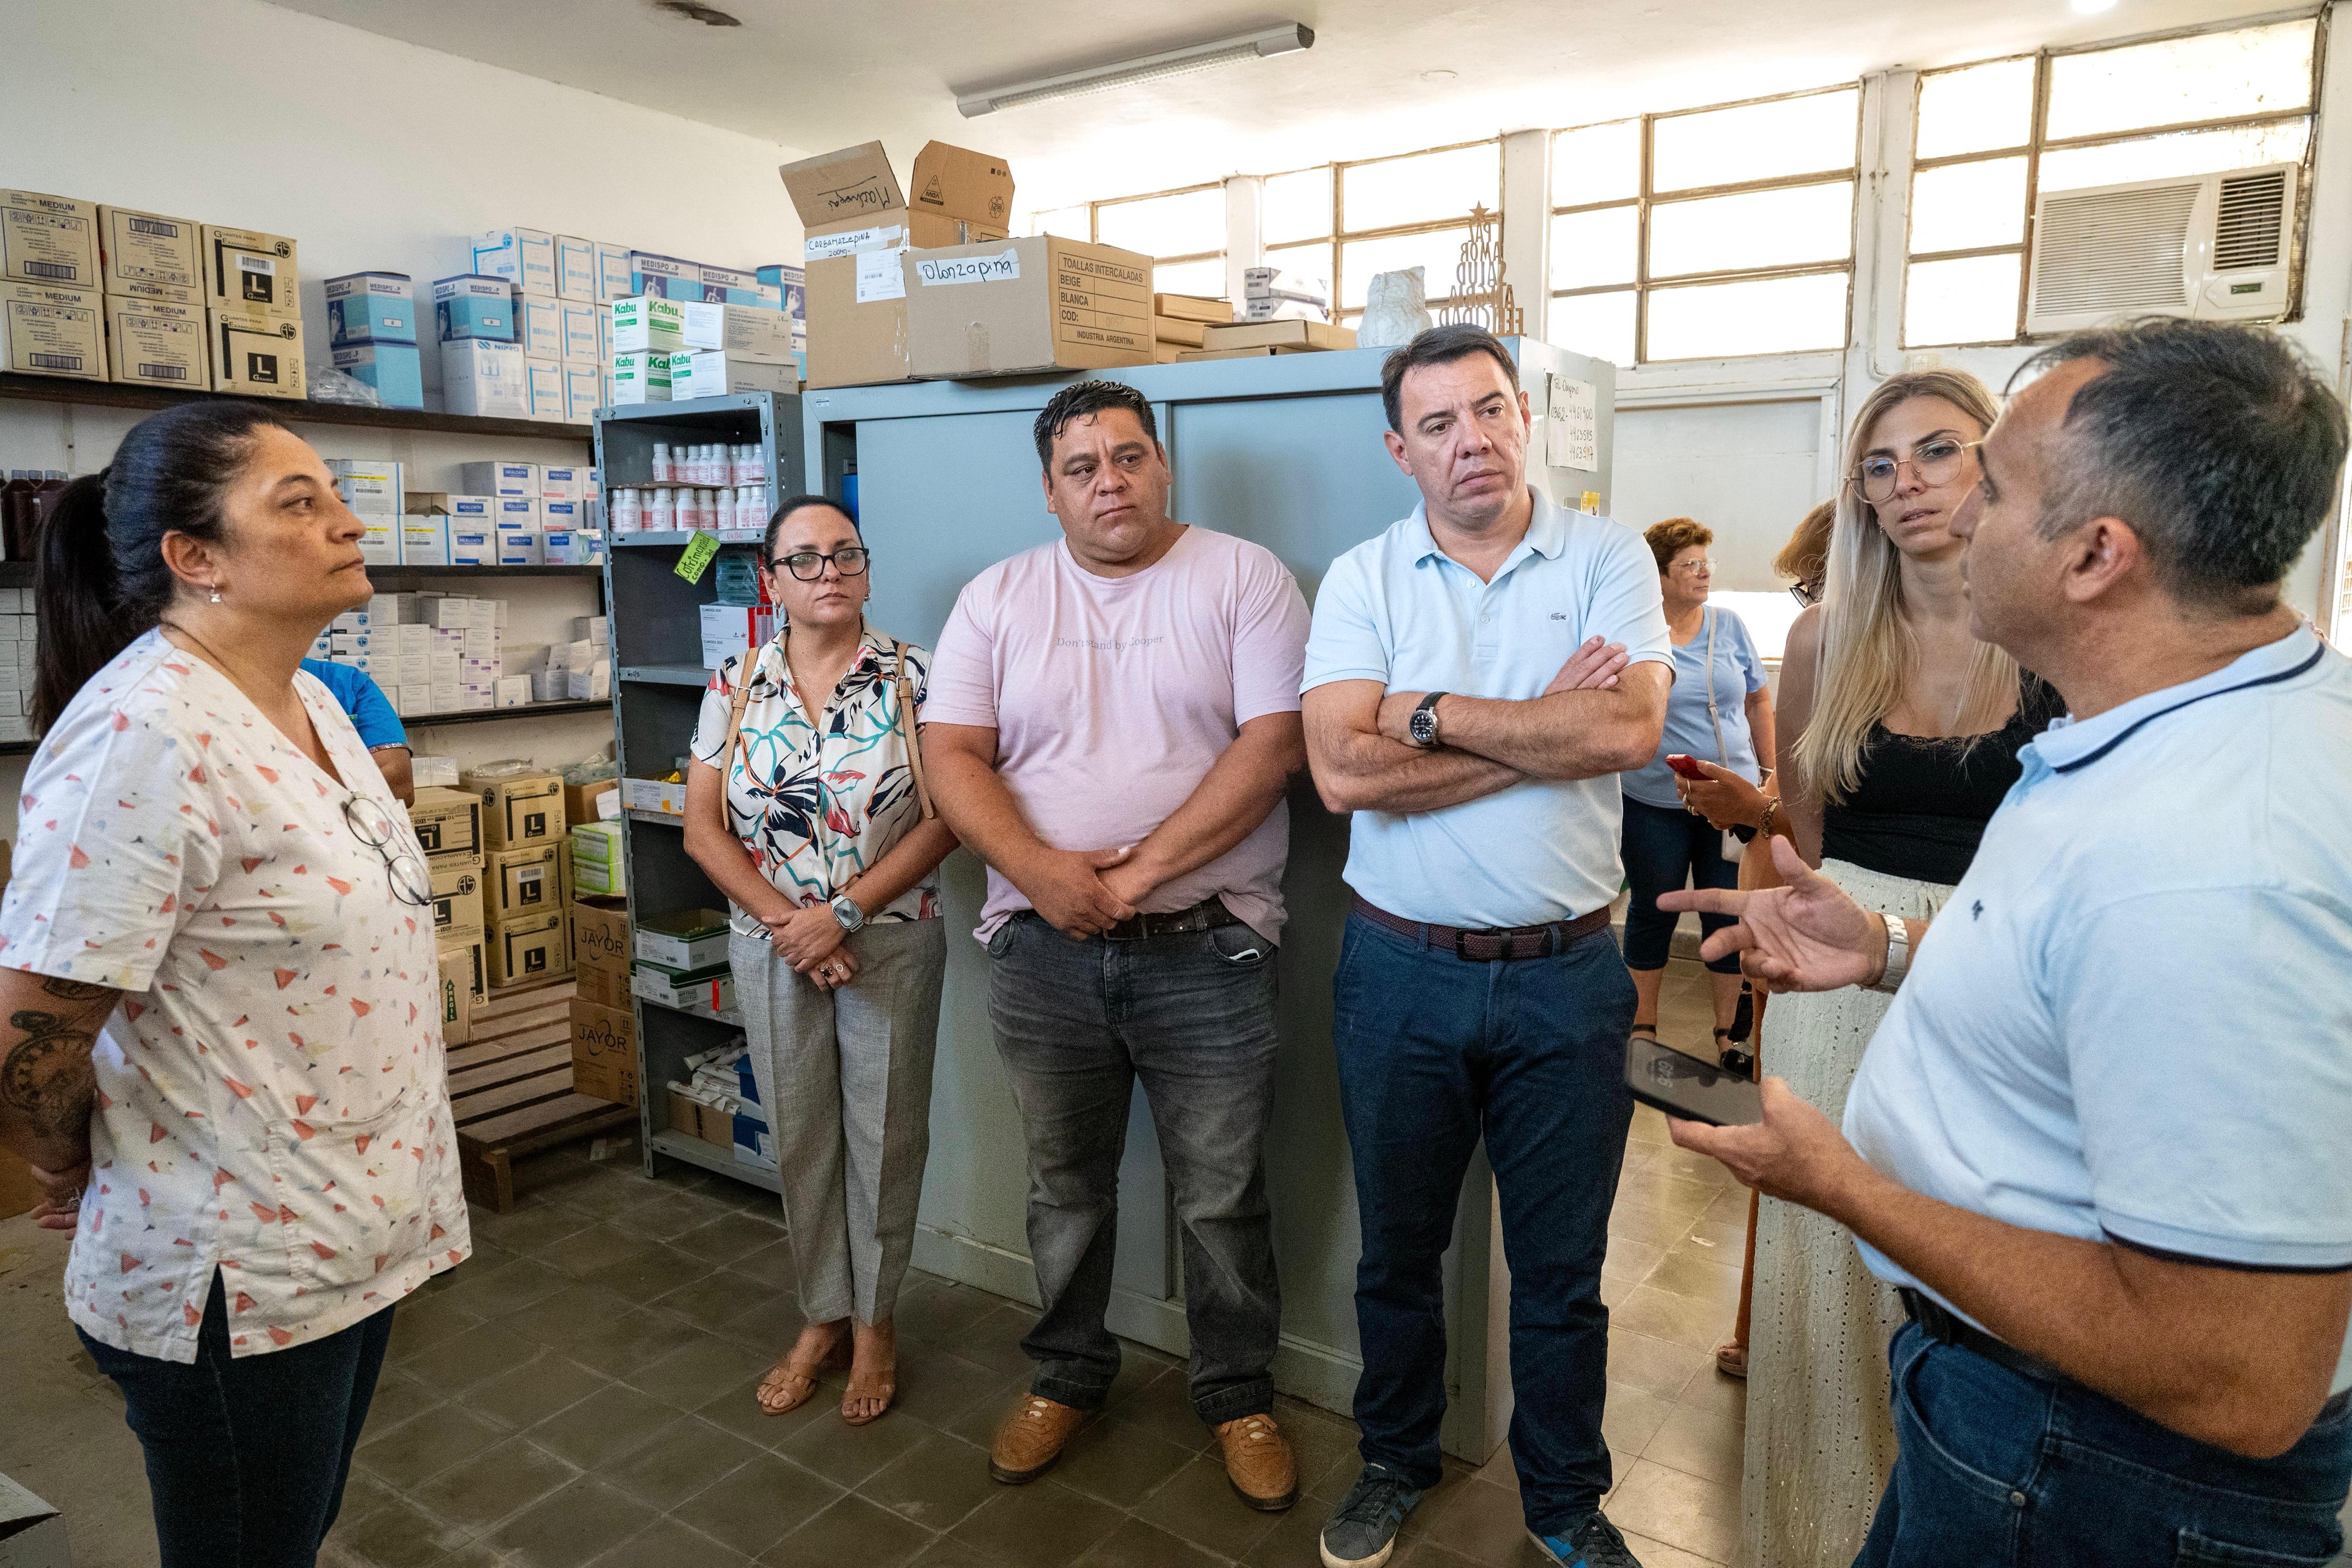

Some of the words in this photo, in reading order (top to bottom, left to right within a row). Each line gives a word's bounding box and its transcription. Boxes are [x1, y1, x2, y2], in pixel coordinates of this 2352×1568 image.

[40, 200, 75, 211] MEDIUM
[641, 259, 669, 270] MEDISPO
[1063, 257, 1093, 272] TOALLAS
[1095, 265, 1143, 283] INTERCALADAS
[703, 271, 729, 281] MEDISPO
[1060, 274, 1081, 287] BEIGE
[130, 285, 163, 295] MEDIUM
[252, 275, 266, 293] L
[45, 292, 81, 302] MEDIUM
[1061, 292, 1088, 306] BLANCA
[153, 306, 186, 315] MEDIUM
[615, 302, 637, 315] Kabu
[649, 301, 678, 317] Kabu
[1061, 310, 1079, 322] COD:
[1077, 331, 1104, 341] INDUSTRIA
[1106, 335, 1134, 345] ARGENTINA
[257, 357, 271, 374] L
[615, 356, 634, 367] Kabu
[672, 354, 691, 366] Kabu
[1570, 443, 1594, 461] 446357
[1057, 638, 1084, 647] Don't
[1115, 640, 1127, 652] by
[531, 816, 541, 830] L
[421, 833, 433, 848] L
[449, 856, 481, 866] GUANTES
[526, 883, 537, 897] L
[434, 904, 446, 919] L
[581, 931, 624, 955] JAYOR
[531, 951, 541, 965] L
[579, 1027, 627, 1051] JAYOR
